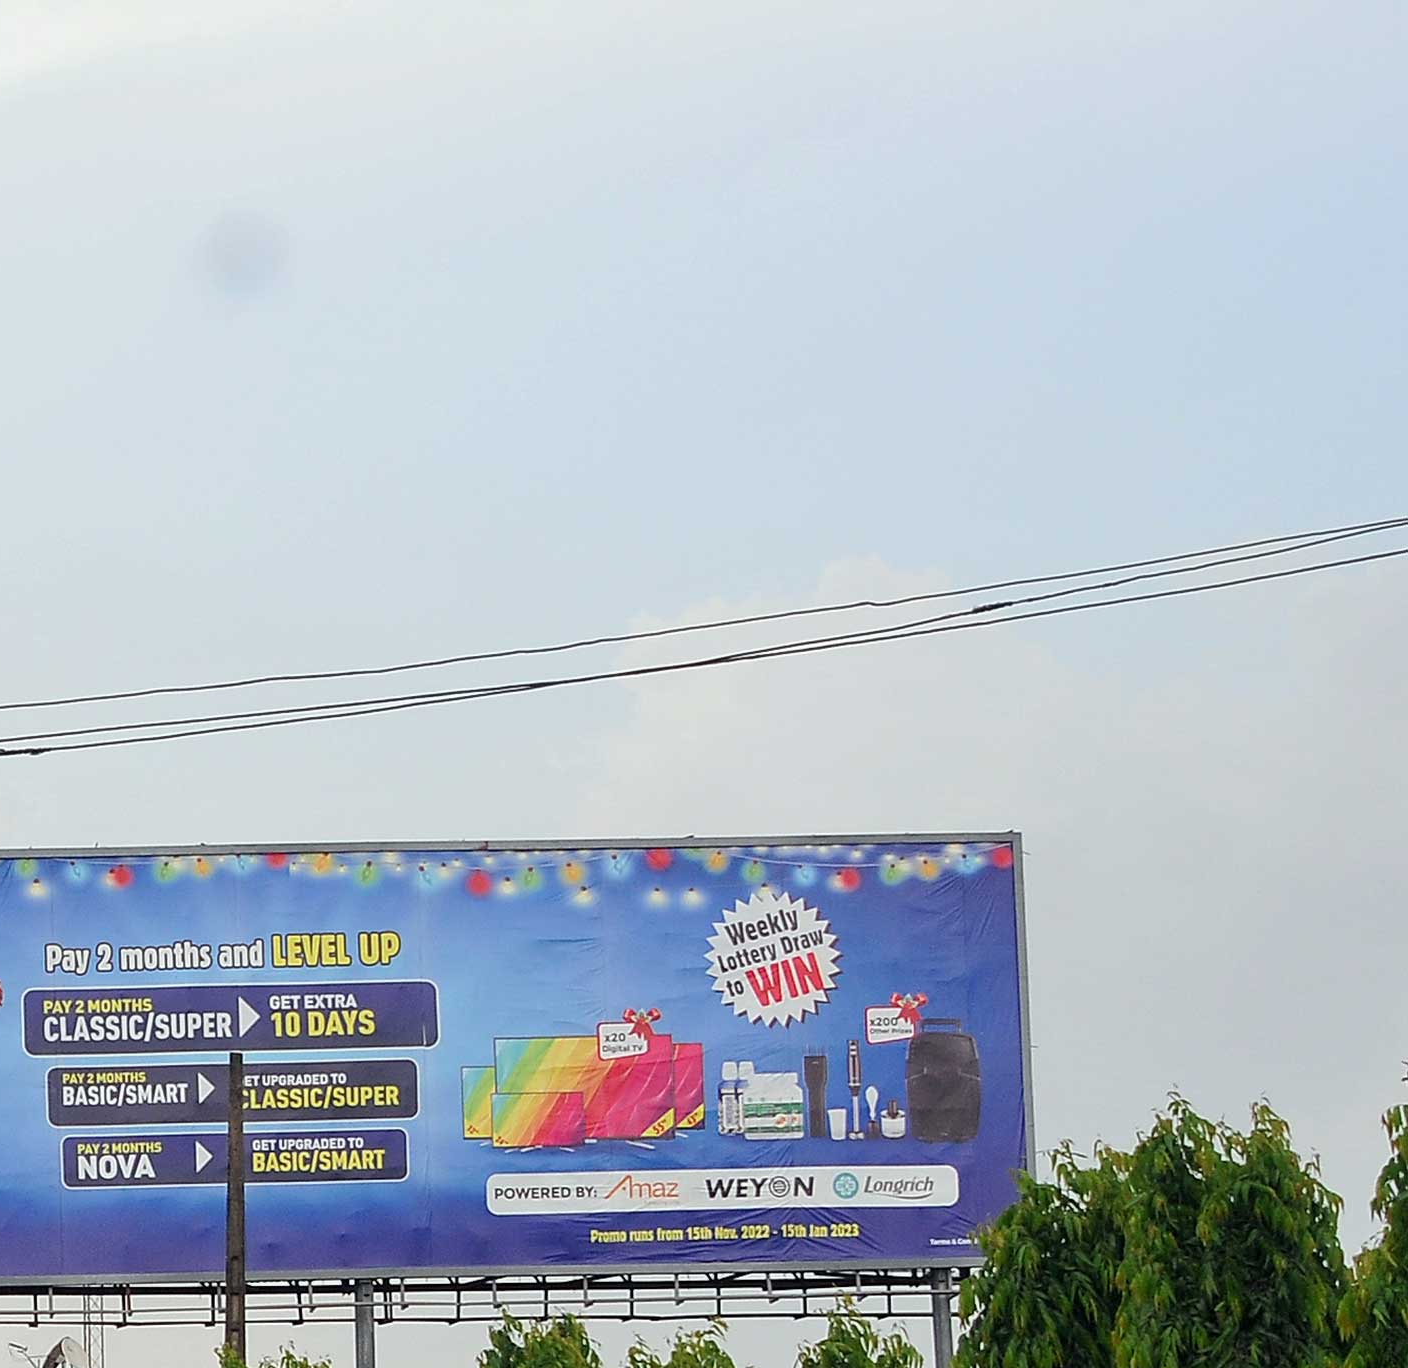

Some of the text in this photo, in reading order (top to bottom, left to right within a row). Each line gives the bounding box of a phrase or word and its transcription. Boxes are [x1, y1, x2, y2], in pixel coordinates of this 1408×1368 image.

[724, 908, 799, 946] Weekly
[44, 931, 401, 975] Pay 2 months and LEVEL UP
[716, 928, 825, 974] Lottery Draw
[726, 951, 825, 1007] to WIN
[43, 998, 153, 1014] PAY 2 MONTHS
[269, 993, 358, 1010] GET EXTRA
[43, 1011, 233, 1043] CLASSIC/SUPER
[270, 1009, 376, 1038] 10 DAYS
[604, 1032, 626, 1043] x20
[61, 1072, 147, 1085] PAY 2 MONTHS
[243, 1072, 347, 1087] ET UPGRADED TO
[62, 1082, 189, 1107] BASIC/SMART
[76, 1141, 163, 1155] PAY 2 MONTHS
[252, 1137, 364, 1151] GET UPGRADED TO
[77, 1153, 157, 1180] NOVA
[252, 1149, 386, 1173] BASIC/SMART
[494, 1185, 598, 1200] POWERED BY:
[603, 1174, 680, 1200] Amaz
[705, 1175, 815, 1199] WEYON
[863, 1175, 935, 1195] Longrich
[590, 1229, 627, 1243] Promo
[629, 1229, 654, 1242] runs
[656, 1227, 684, 1241] from
[686, 1226, 713, 1241] 15th
[740, 1224, 771, 1239] 2022
[781, 1223, 807, 1238] 15th
[809, 1223, 829, 1238] Jan
[830, 1223, 860, 1238] 2023
